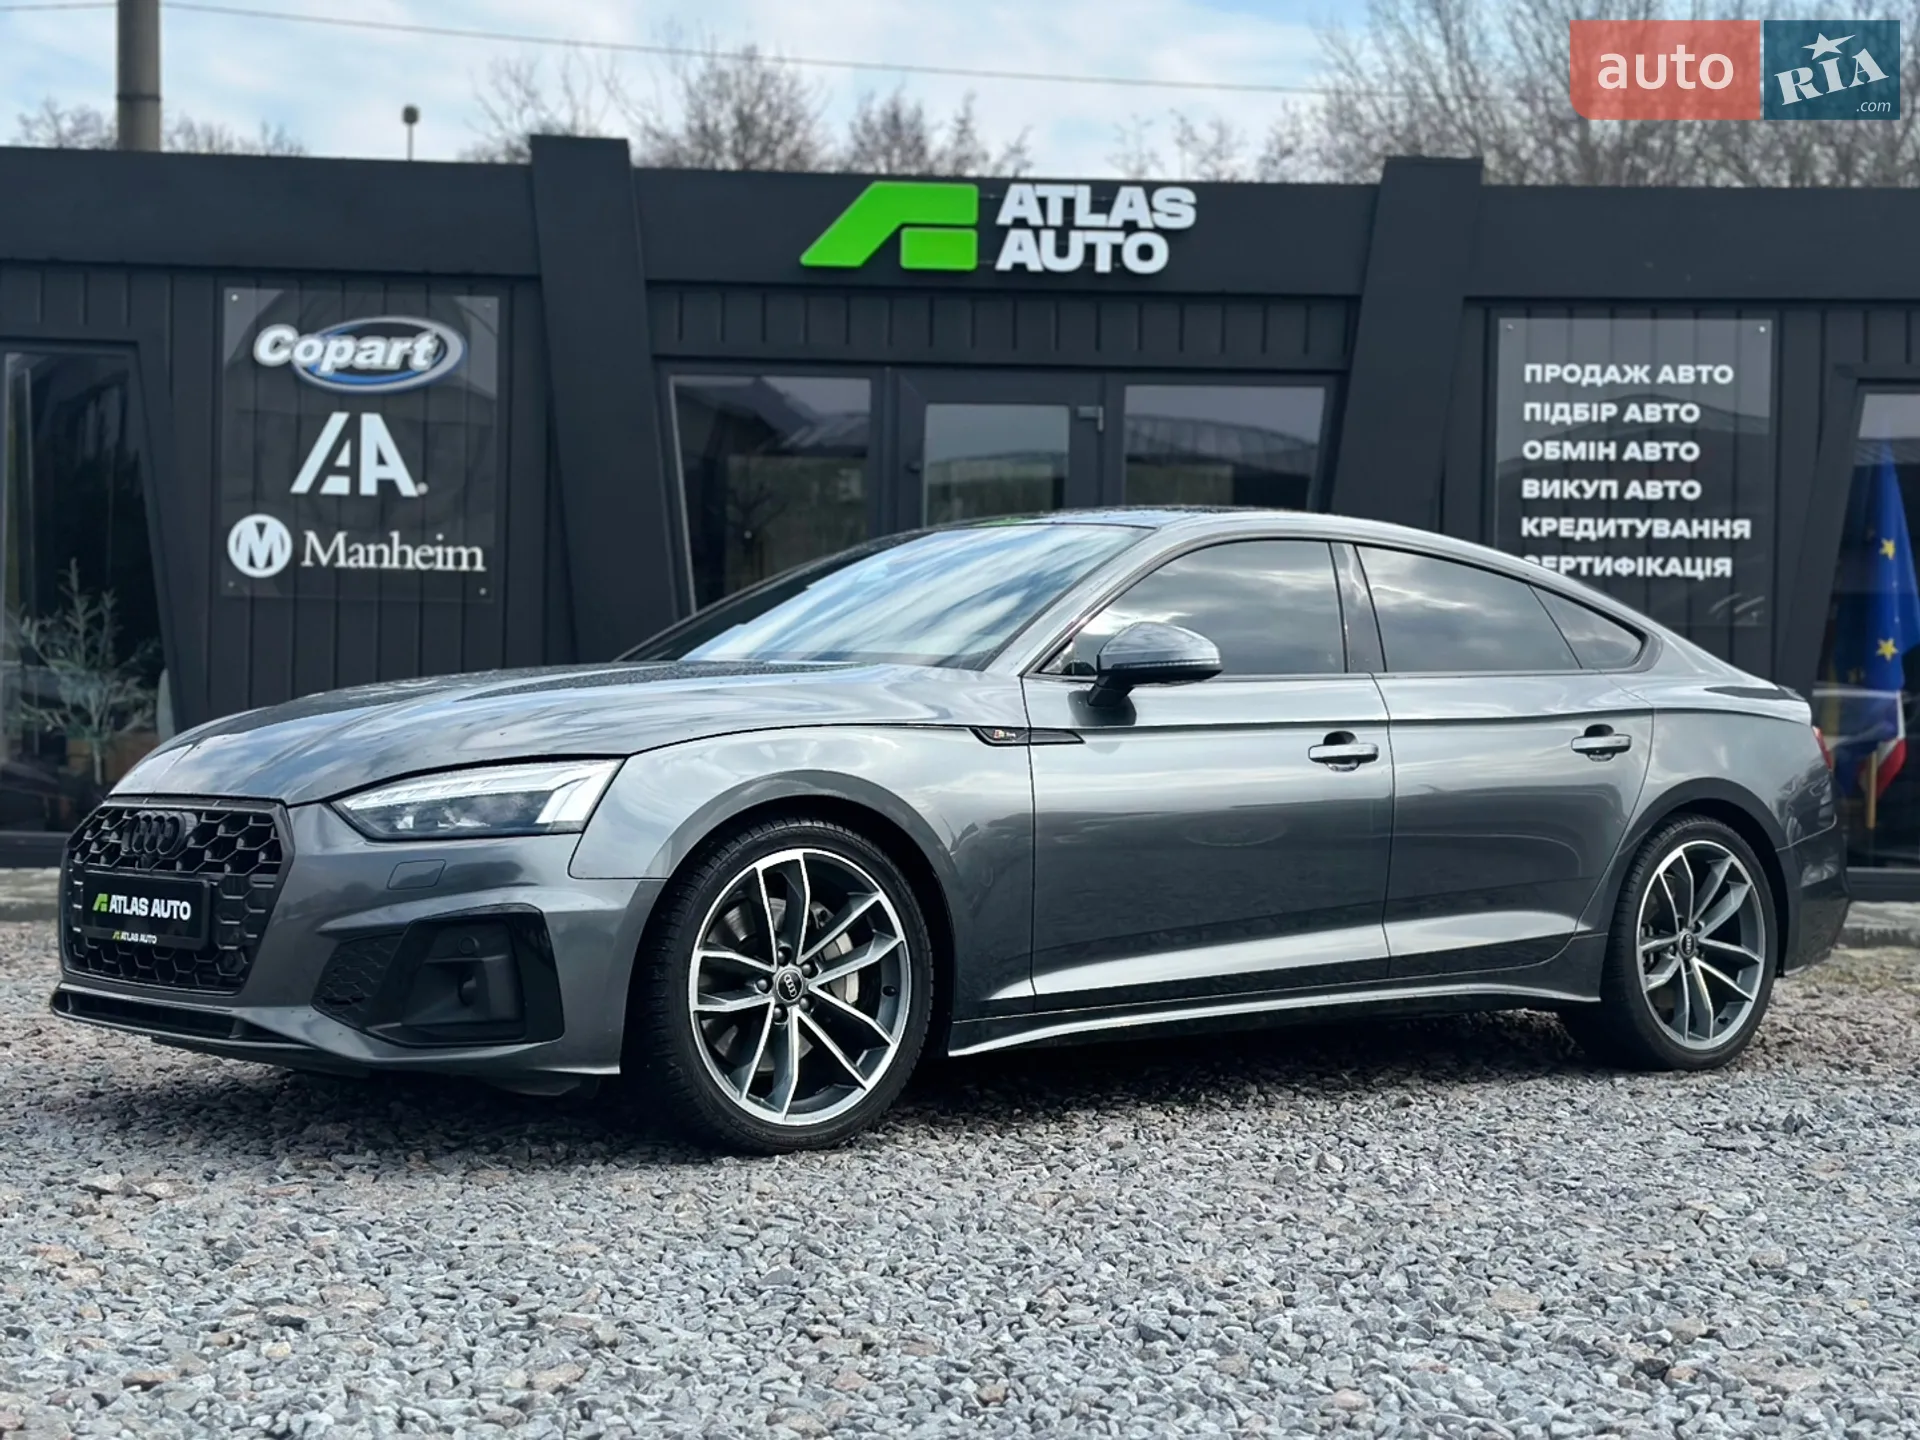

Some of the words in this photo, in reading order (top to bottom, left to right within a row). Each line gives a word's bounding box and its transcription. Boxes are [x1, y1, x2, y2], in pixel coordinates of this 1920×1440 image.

[996, 183, 1197, 229] ATLAS
[995, 229, 1169, 274] AUTO
[254, 324, 438, 376] Copart
[1524, 363, 1651, 387] ПРОДАЖ
[1656, 364, 1734, 385] АВТО
[1523, 402, 1618, 425] ПІДБІР
[1623, 403, 1701, 423] АВТО
[1522, 441, 1617, 461] ОБМІН
[1622, 442, 1701, 462] АВТО
[1521, 479, 1618, 499] ВИКУП
[1624, 480, 1702, 500] АВТО
[1521, 517, 1752, 541] КРЕДИТУВАННЯ
[301, 530, 487, 572] Manheim
[109, 895, 149, 916] ATLAS
[150, 898, 191, 921] AUTO
